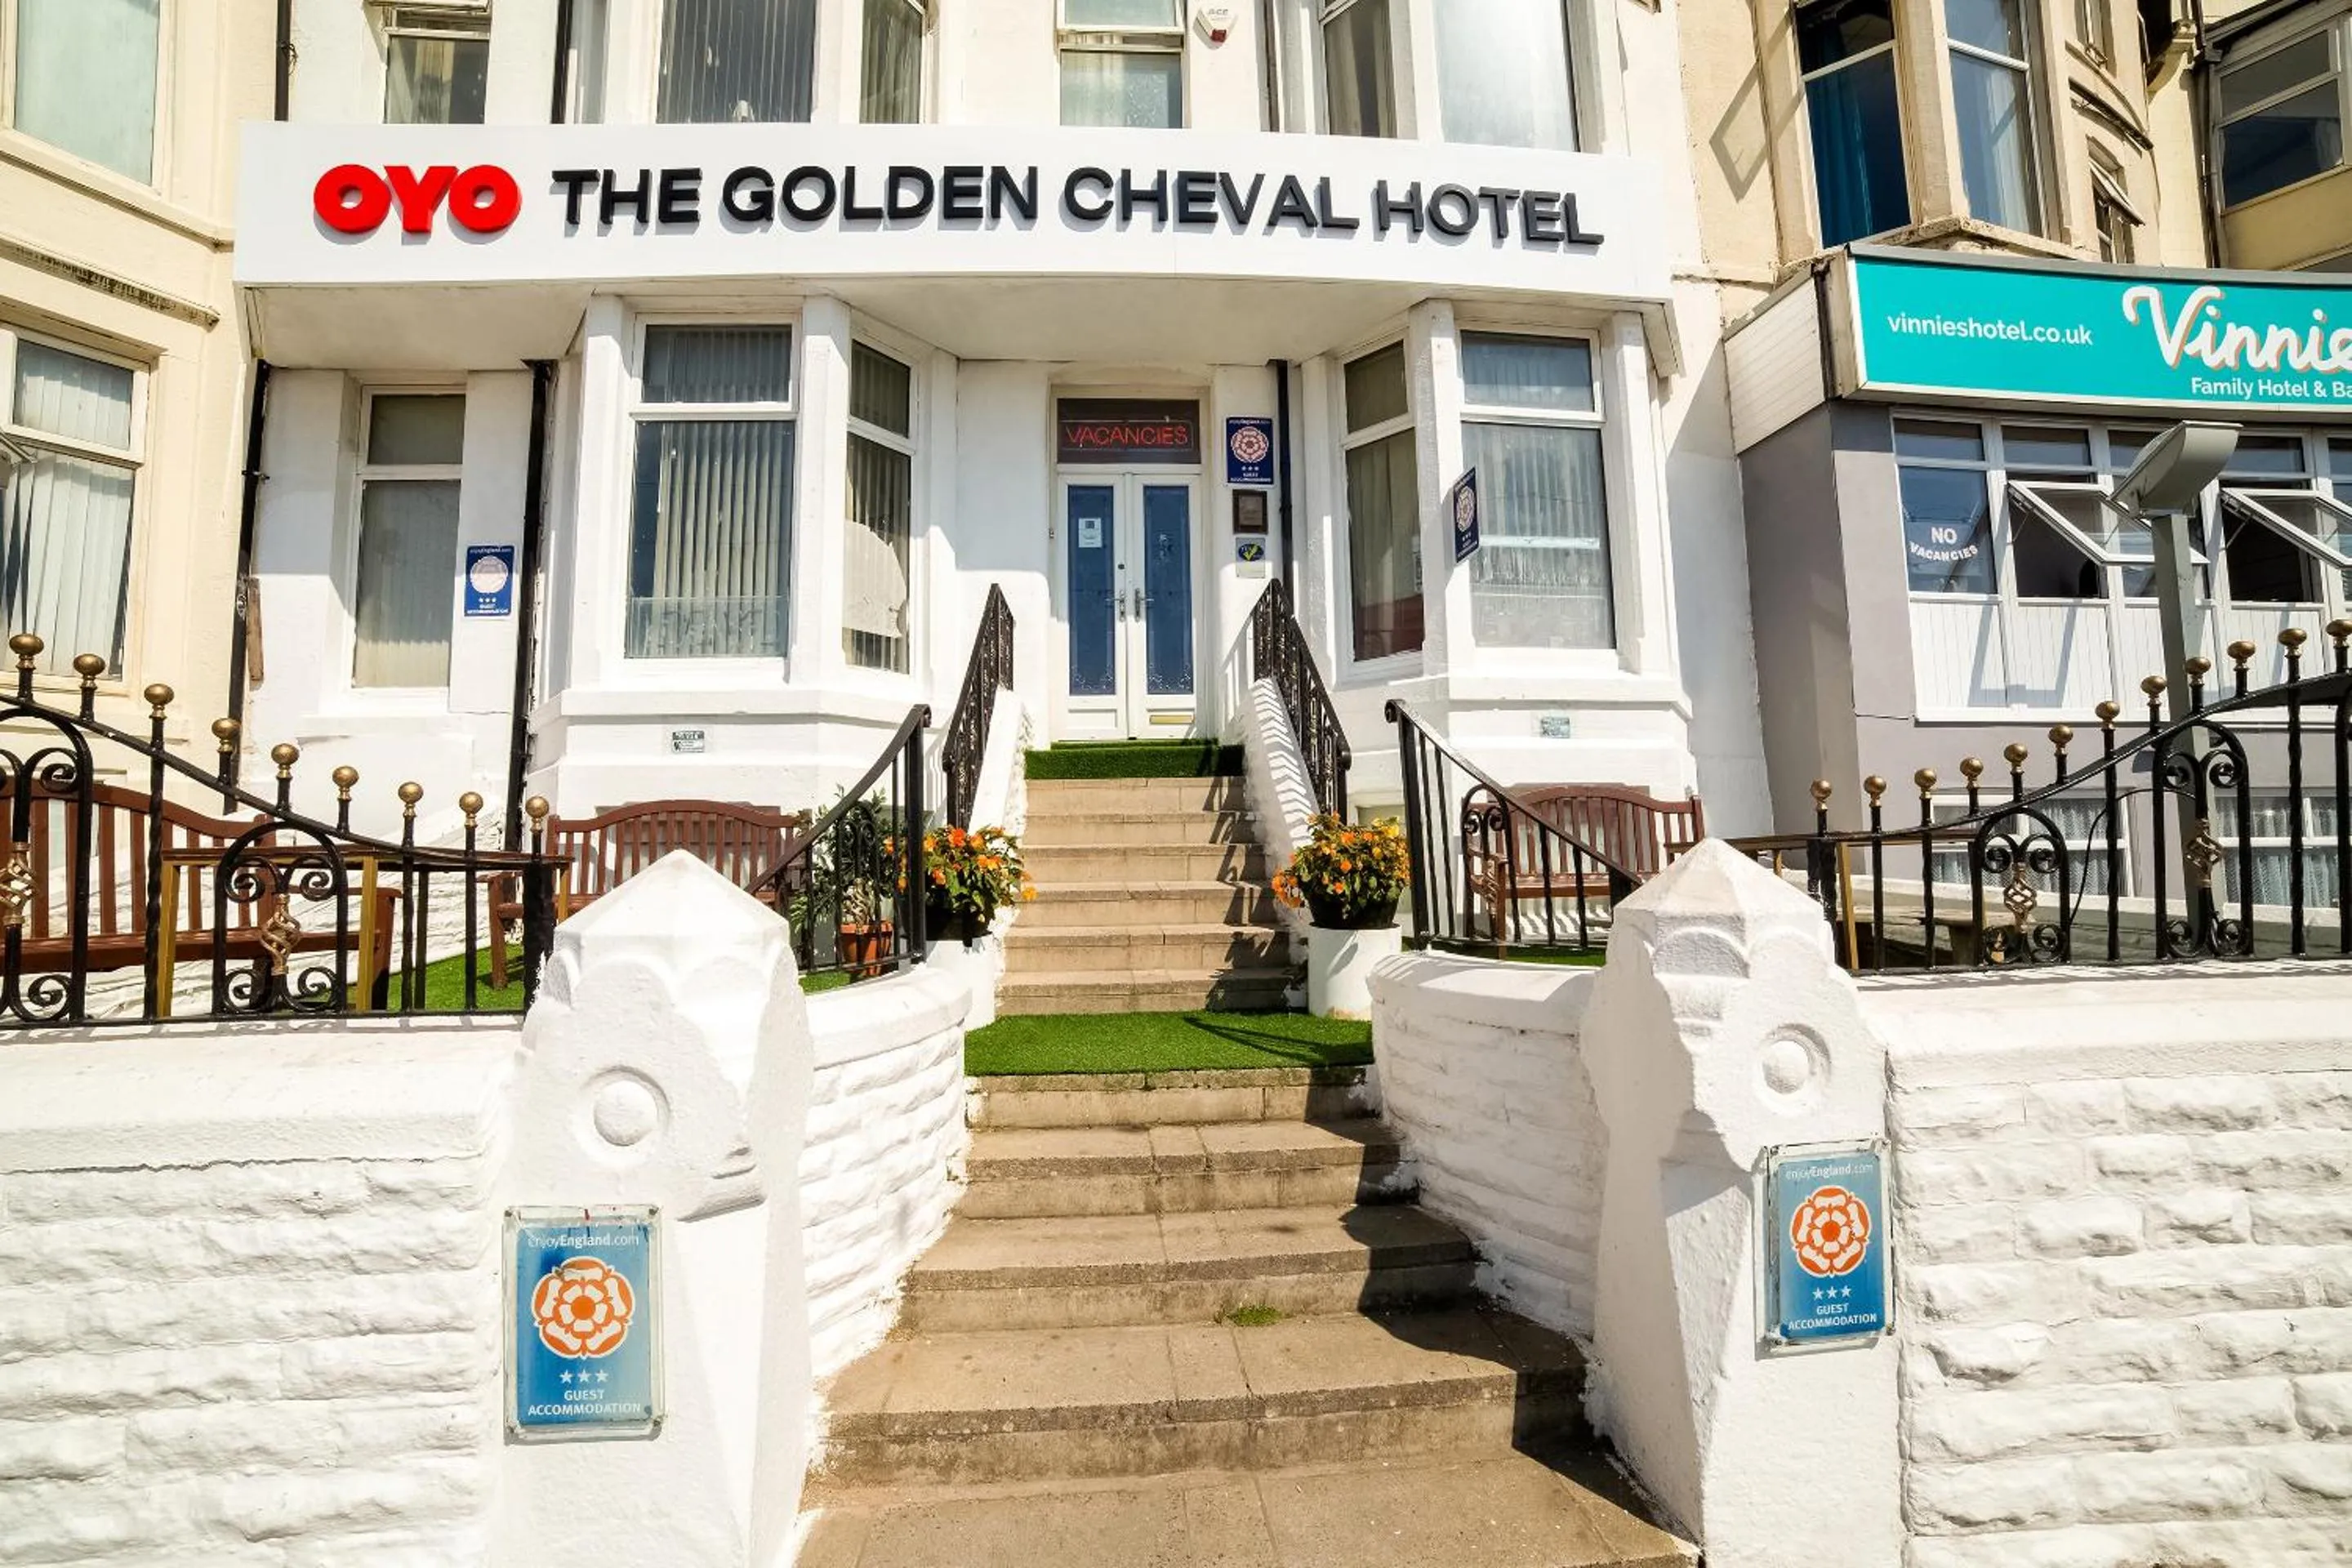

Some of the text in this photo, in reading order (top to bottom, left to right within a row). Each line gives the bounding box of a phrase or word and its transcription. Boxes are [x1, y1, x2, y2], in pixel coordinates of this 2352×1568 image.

[313, 164, 1605, 245] OYO THE GOLDEN CHEVAL HOTEL
[1887, 311, 2093, 345] vinnieshotel.co.uk
[2191, 377, 2253, 399] Family
[2258, 379, 2310, 398] Hotel
[2314, 381, 2327, 398] &
[1066, 425, 1188, 445] VACANCIES
[1931, 527, 1958, 545] NO
[1910, 541, 1978, 561] VACANCIES
[1816, 1303, 1849, 1315] GUEST
[1788, 1313, 1877, 1330] ACCOMMODATION
[564, 1389, 604, 1401] GUEST
[528, 1403, 640, 1416] ACCOMMODATION
